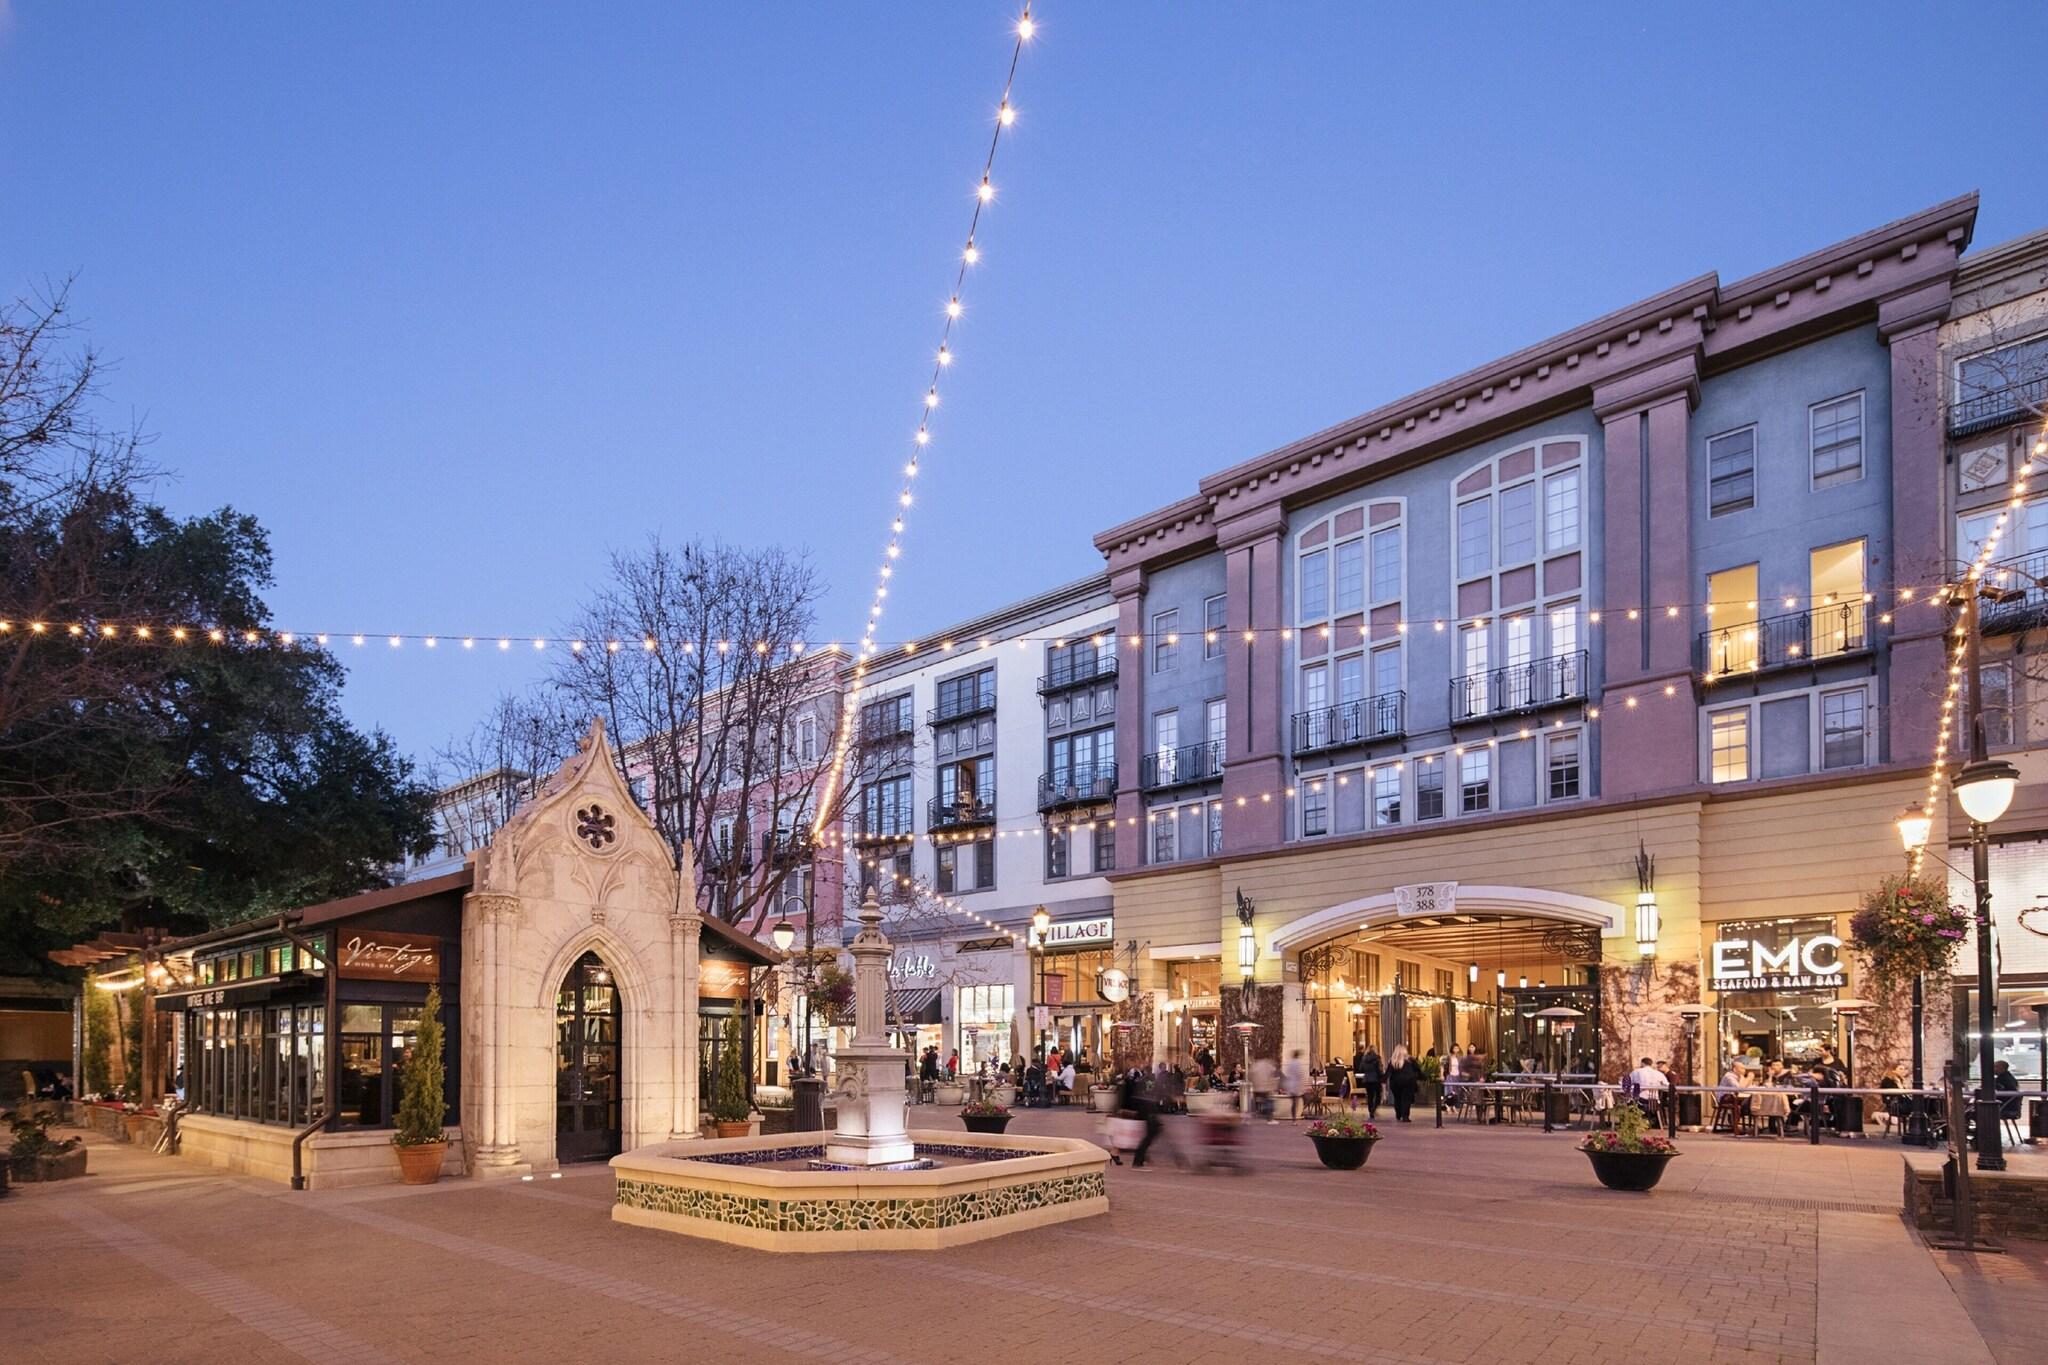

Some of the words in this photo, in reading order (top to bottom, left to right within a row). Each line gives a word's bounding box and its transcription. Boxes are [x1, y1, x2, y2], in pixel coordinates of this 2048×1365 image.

[1416, 886, 1434, 898] 378
[1416, 900, 1435, 912] 388
[345, 936, 433, 974] Vintage
[1712, 935, 1844, 979] EMC
[1712, 978, 1767, 990] SEAFOOD
[1771, 976, 1780, 987] &
[1783, 975, 1811, 987] RAW
[1815, 973, 1843, 986] BAR
